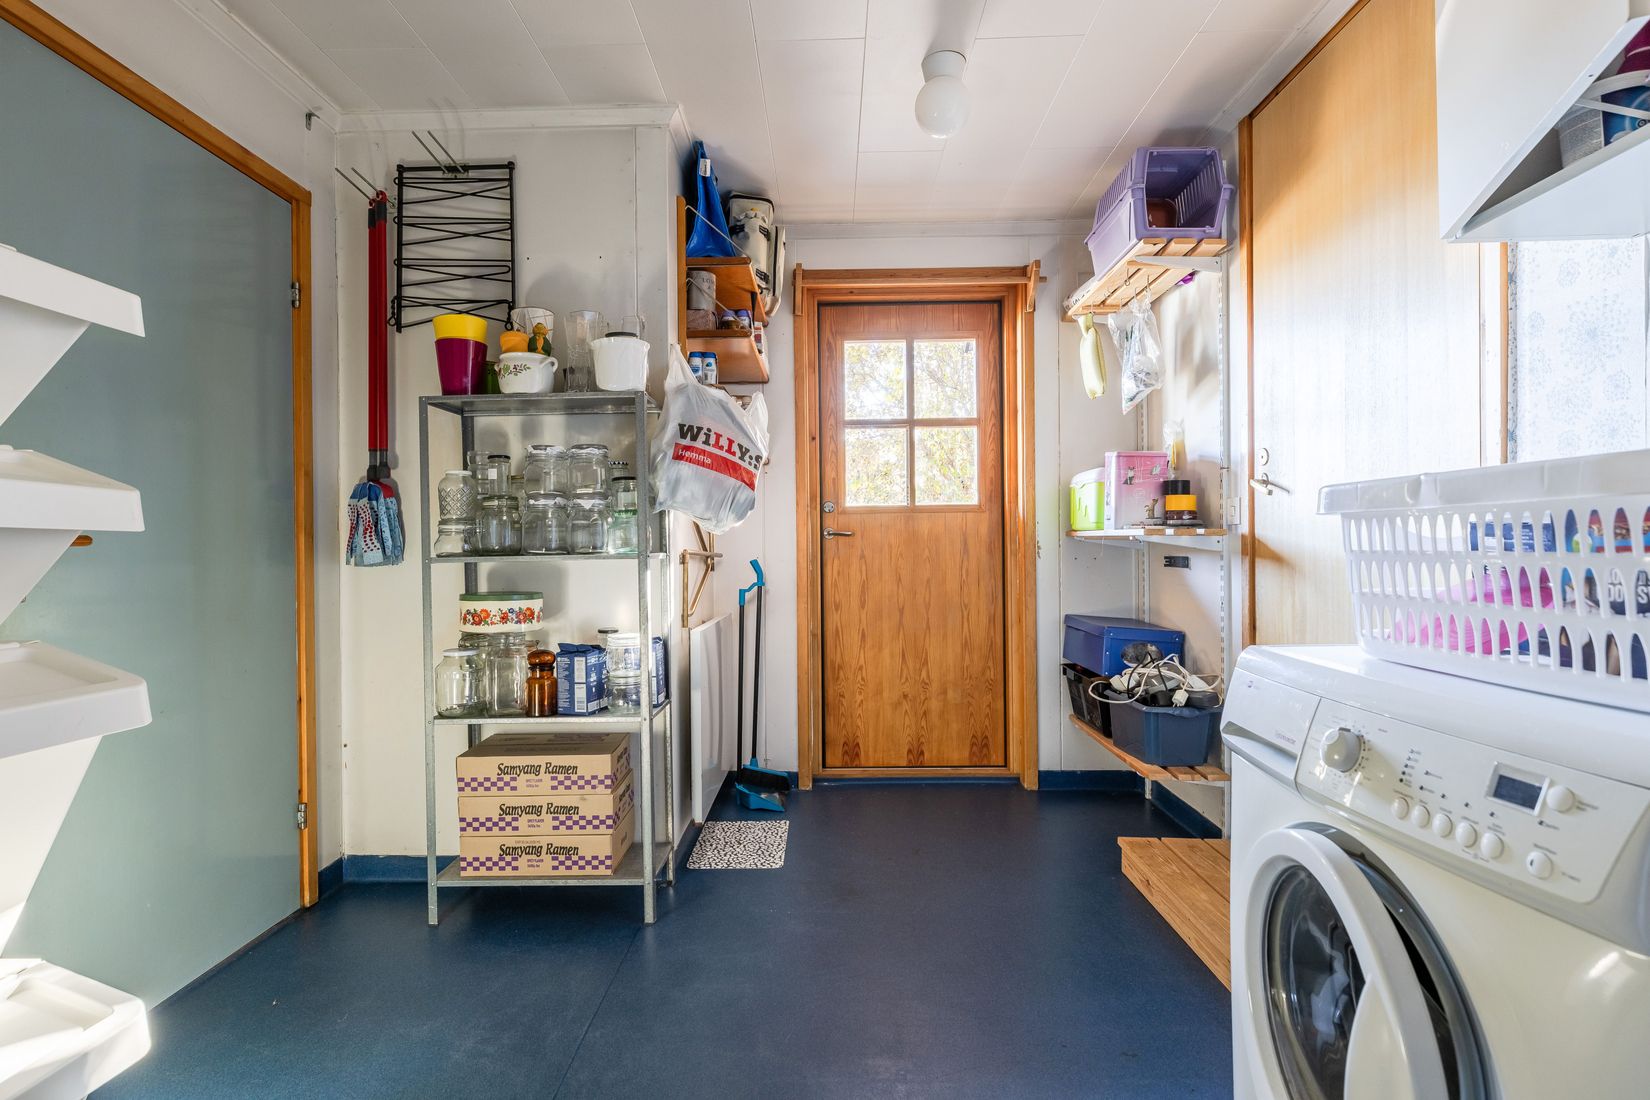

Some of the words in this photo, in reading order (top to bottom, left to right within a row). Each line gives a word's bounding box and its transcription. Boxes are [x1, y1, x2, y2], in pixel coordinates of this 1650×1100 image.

[678, 448, 711, 464] Hemma
[497, 762, 542, 777] Samyang
[544, 762, 578, 775] Ramen
[498, 803, 543, 818] Samyang
[545, 802, 580, 816] Ramen
[498, 843, 543, 858] Samyang
[545, 842, 579, 856] Ramen
